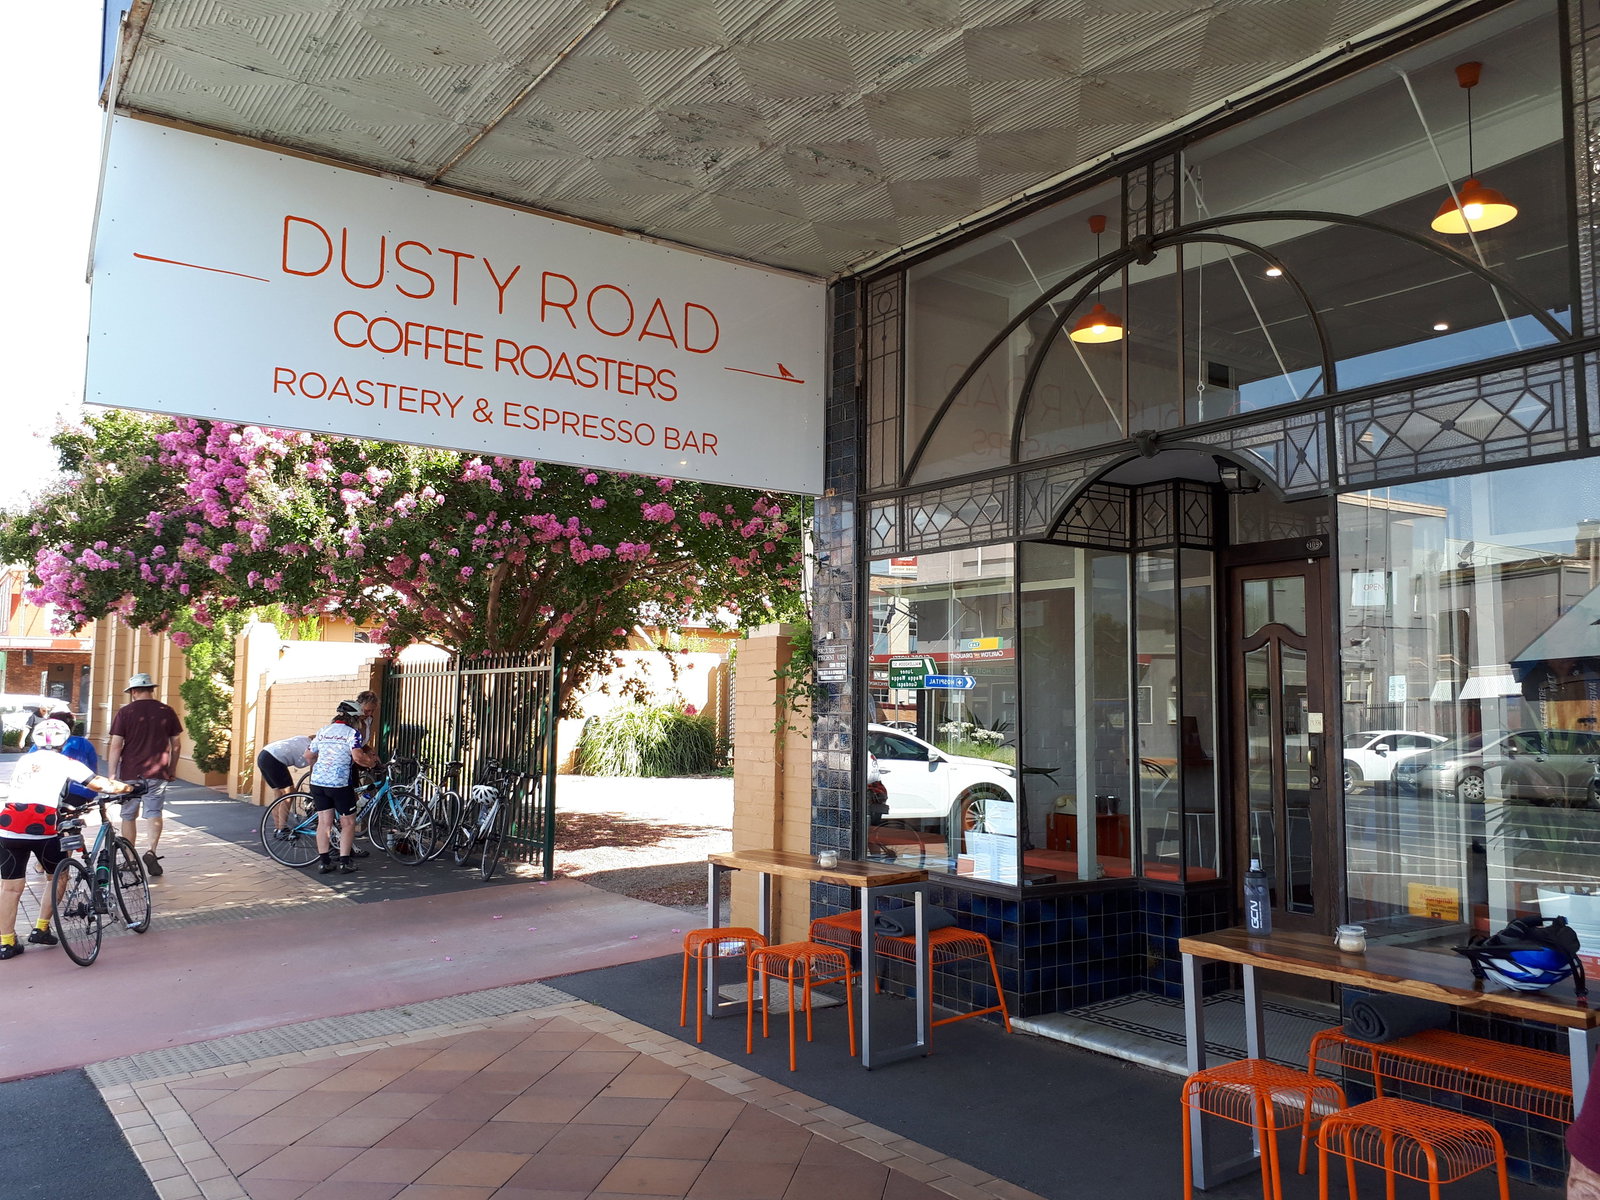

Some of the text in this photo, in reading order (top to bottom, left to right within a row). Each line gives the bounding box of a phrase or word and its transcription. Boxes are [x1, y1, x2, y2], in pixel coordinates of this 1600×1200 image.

[281, 215, 721, 355] DUSTY ROAD
[333, 309, 679, 402] COFFEE ROASTERS
[273, 367, 719, 456] ROASTERY & ESPRESSO BAR
[1363, 583, 1384, 591] OPEN
[1249, 899, 1260, 929] GCN
